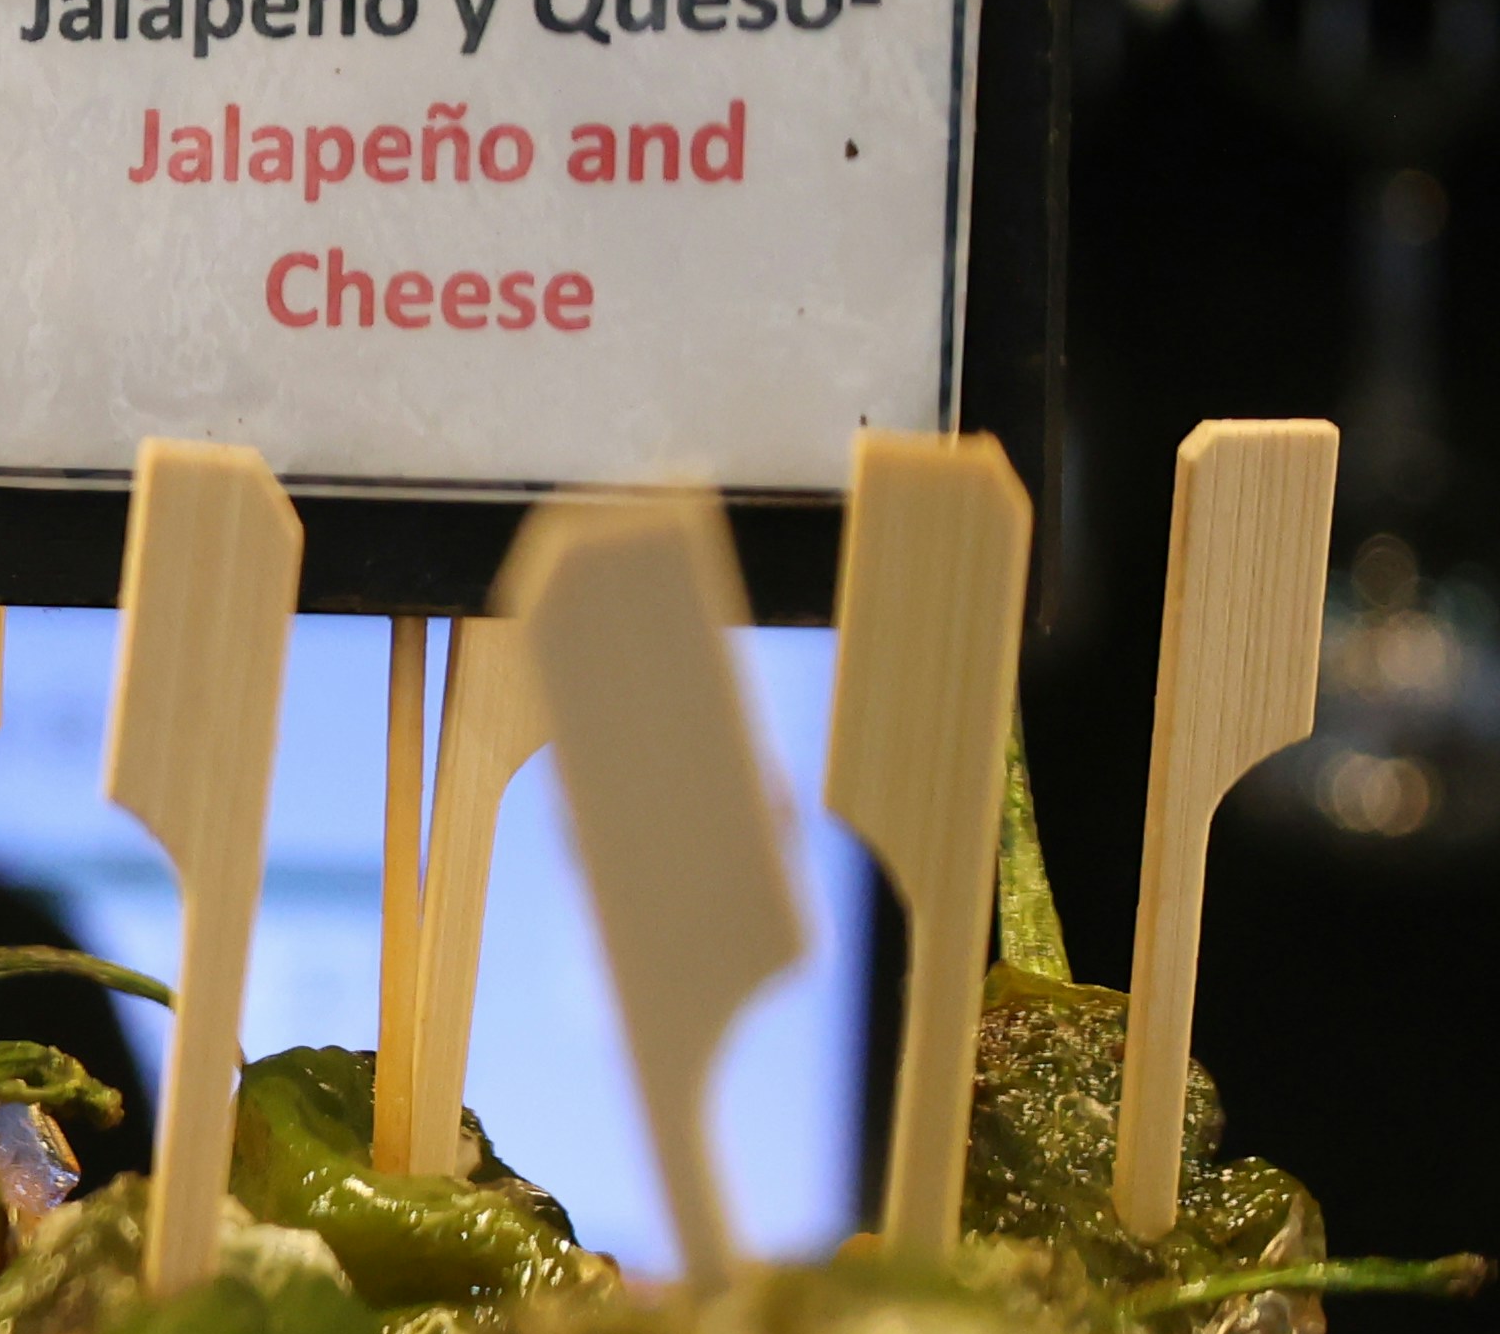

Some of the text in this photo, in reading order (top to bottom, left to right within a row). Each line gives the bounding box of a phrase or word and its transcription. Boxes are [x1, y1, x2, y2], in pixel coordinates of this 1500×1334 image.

[127, 100, 747, 202] Jalapeño and
[264, 247, 595, 332] Cheese
